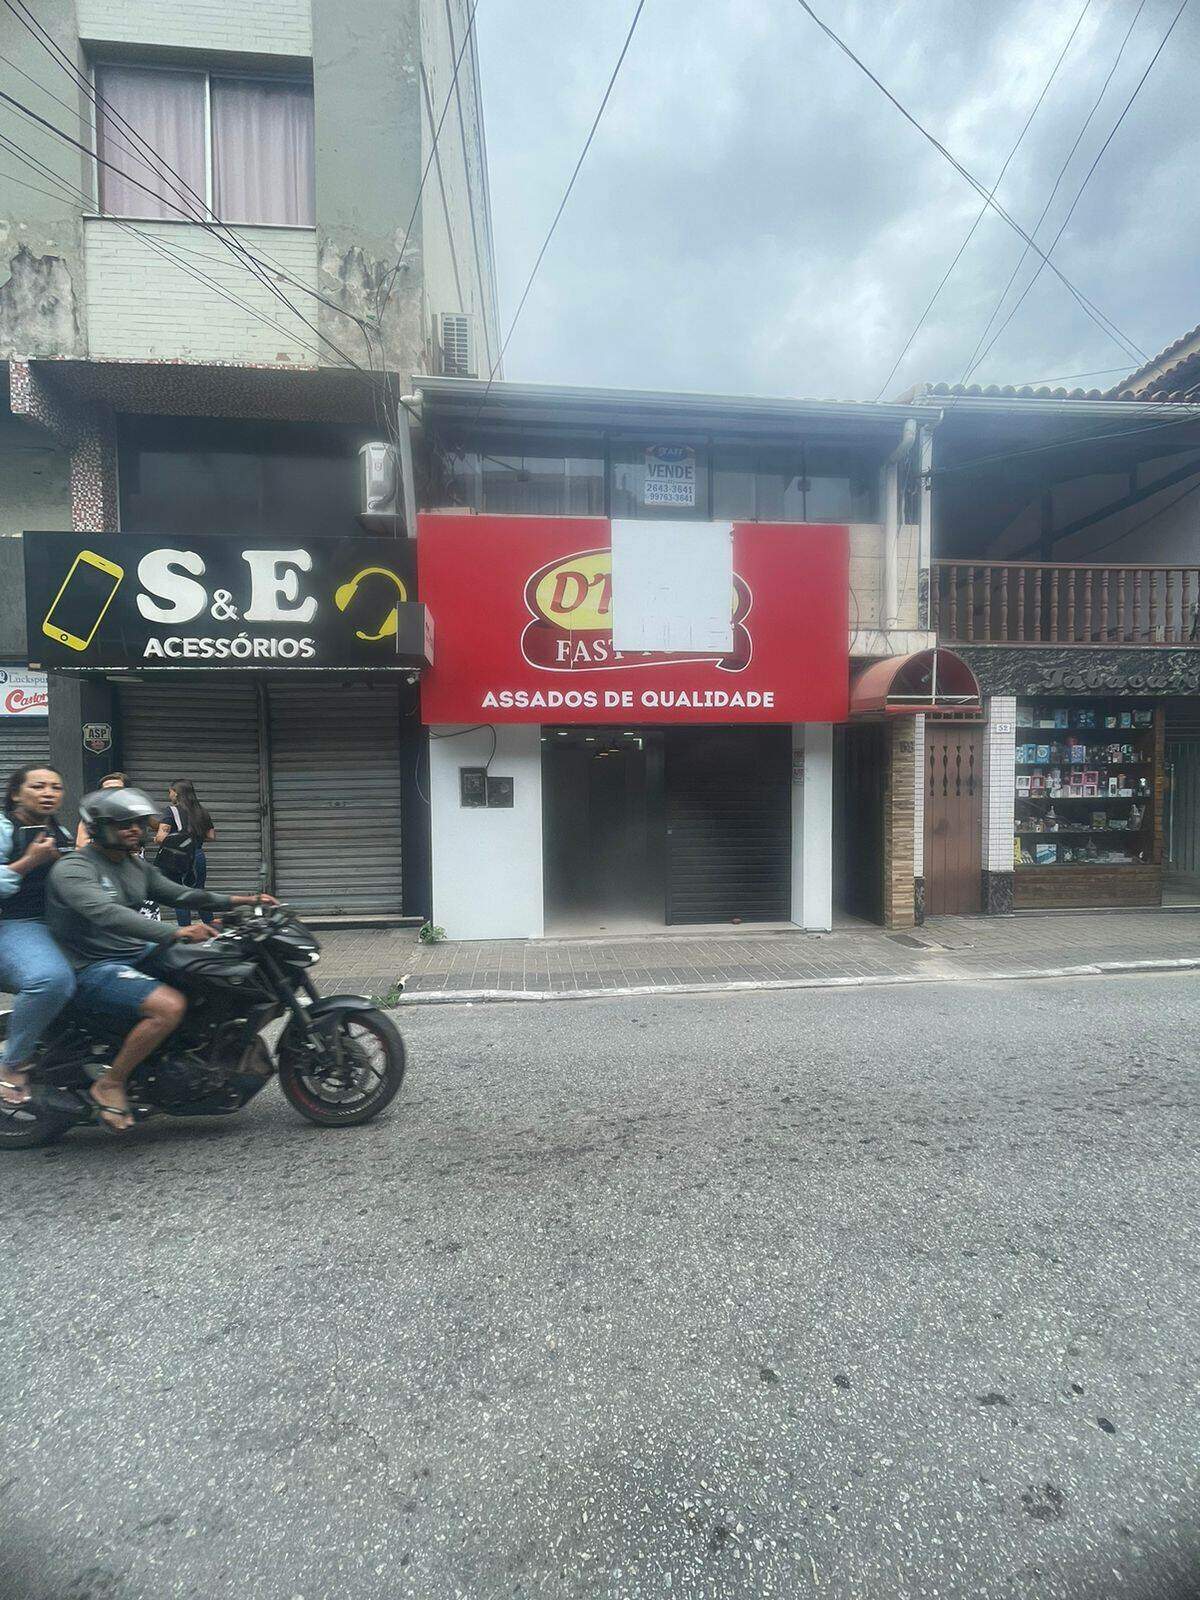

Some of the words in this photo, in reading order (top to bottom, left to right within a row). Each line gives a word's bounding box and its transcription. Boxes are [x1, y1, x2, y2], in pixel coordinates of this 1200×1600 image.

[648, 464, 693, 479] VENDE
[142, 632, 316, 659] ACESSÓRIOS
[481, 691, 598, 708] ASSADOS
[604, 691, 634, 708] DE
[641, 691, 775, 709] QUALIDADE
[88, 728, 107, 738] ASP
